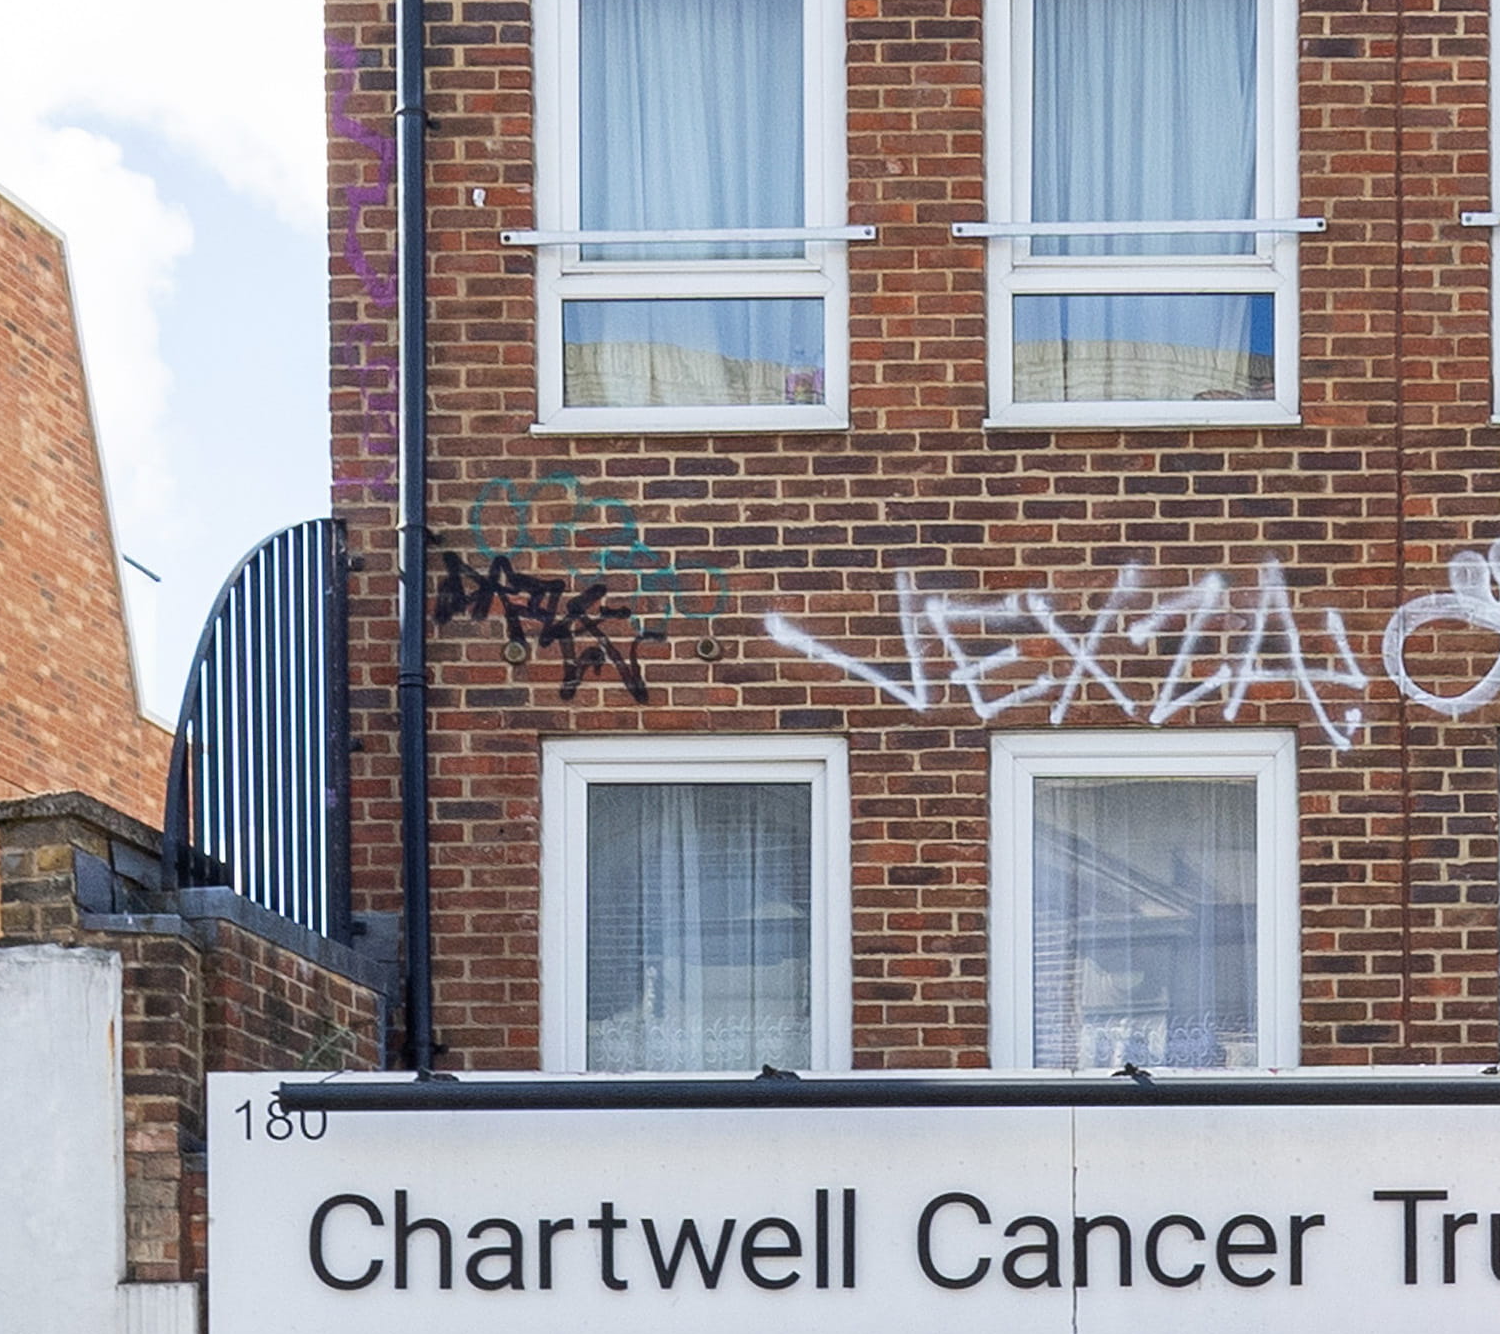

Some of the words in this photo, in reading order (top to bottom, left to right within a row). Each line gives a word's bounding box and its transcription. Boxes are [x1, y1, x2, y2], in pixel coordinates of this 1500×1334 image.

[233, 1099, 329, 1141] 180
[308, 1188, 857, 1292] Chartwell
[917, 1191, 1326, 1289] Cancer
